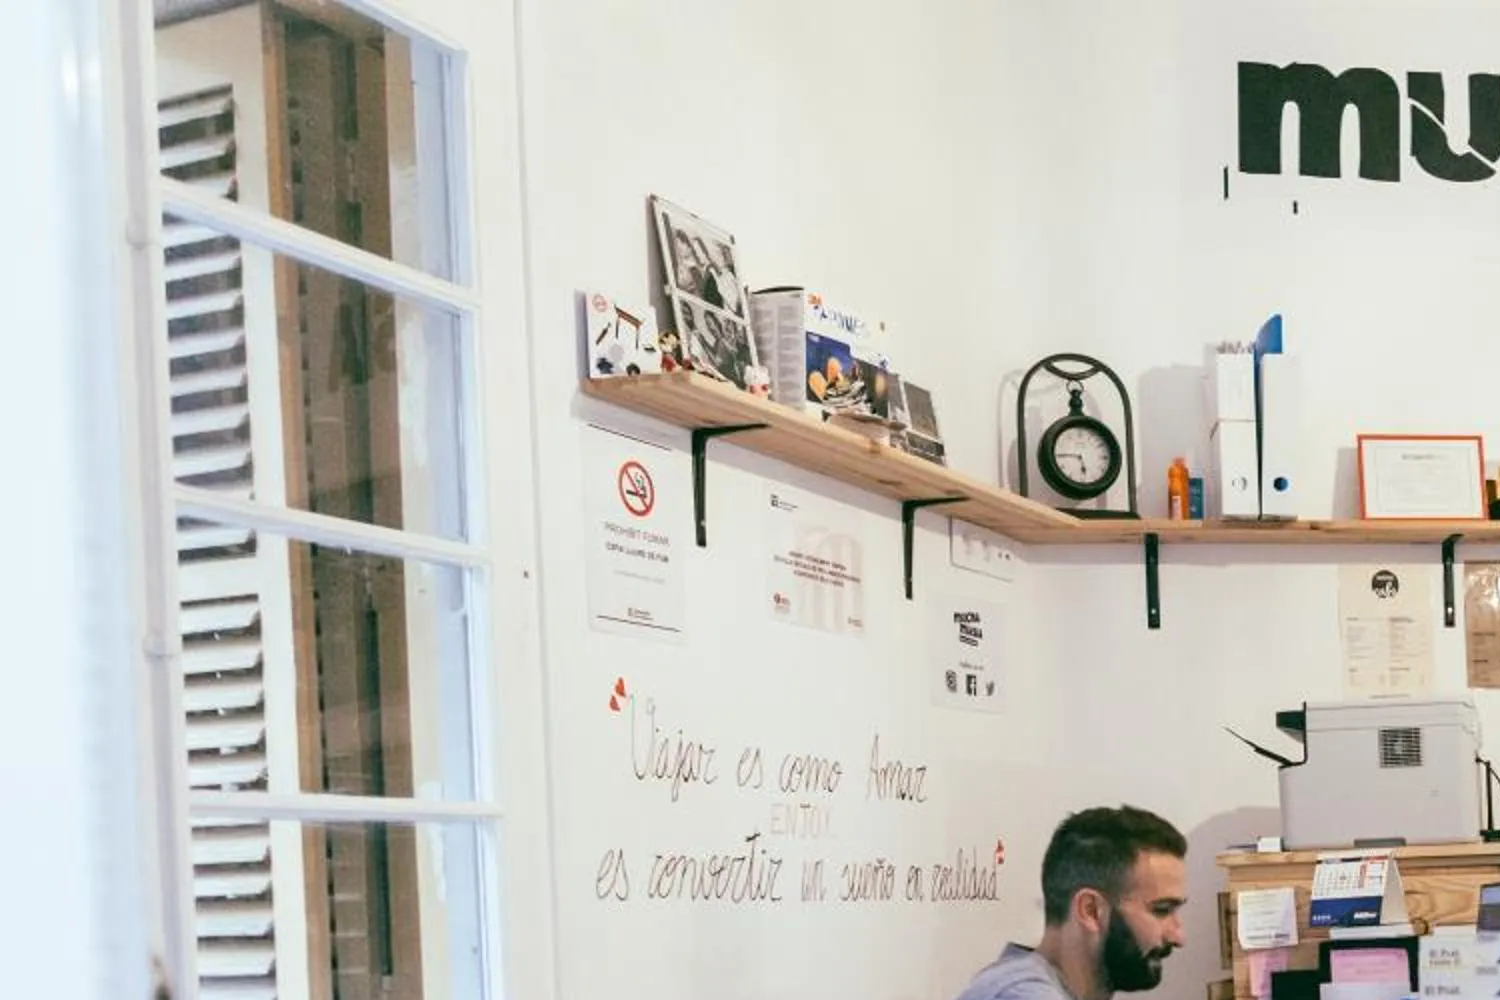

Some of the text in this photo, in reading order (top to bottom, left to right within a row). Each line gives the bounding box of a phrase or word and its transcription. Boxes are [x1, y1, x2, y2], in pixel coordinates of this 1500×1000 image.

[630, 694, 928, 803] Viajar es como Amar
[596, 848, 629, 901] es
[649, 832, 783, 903] convertir
